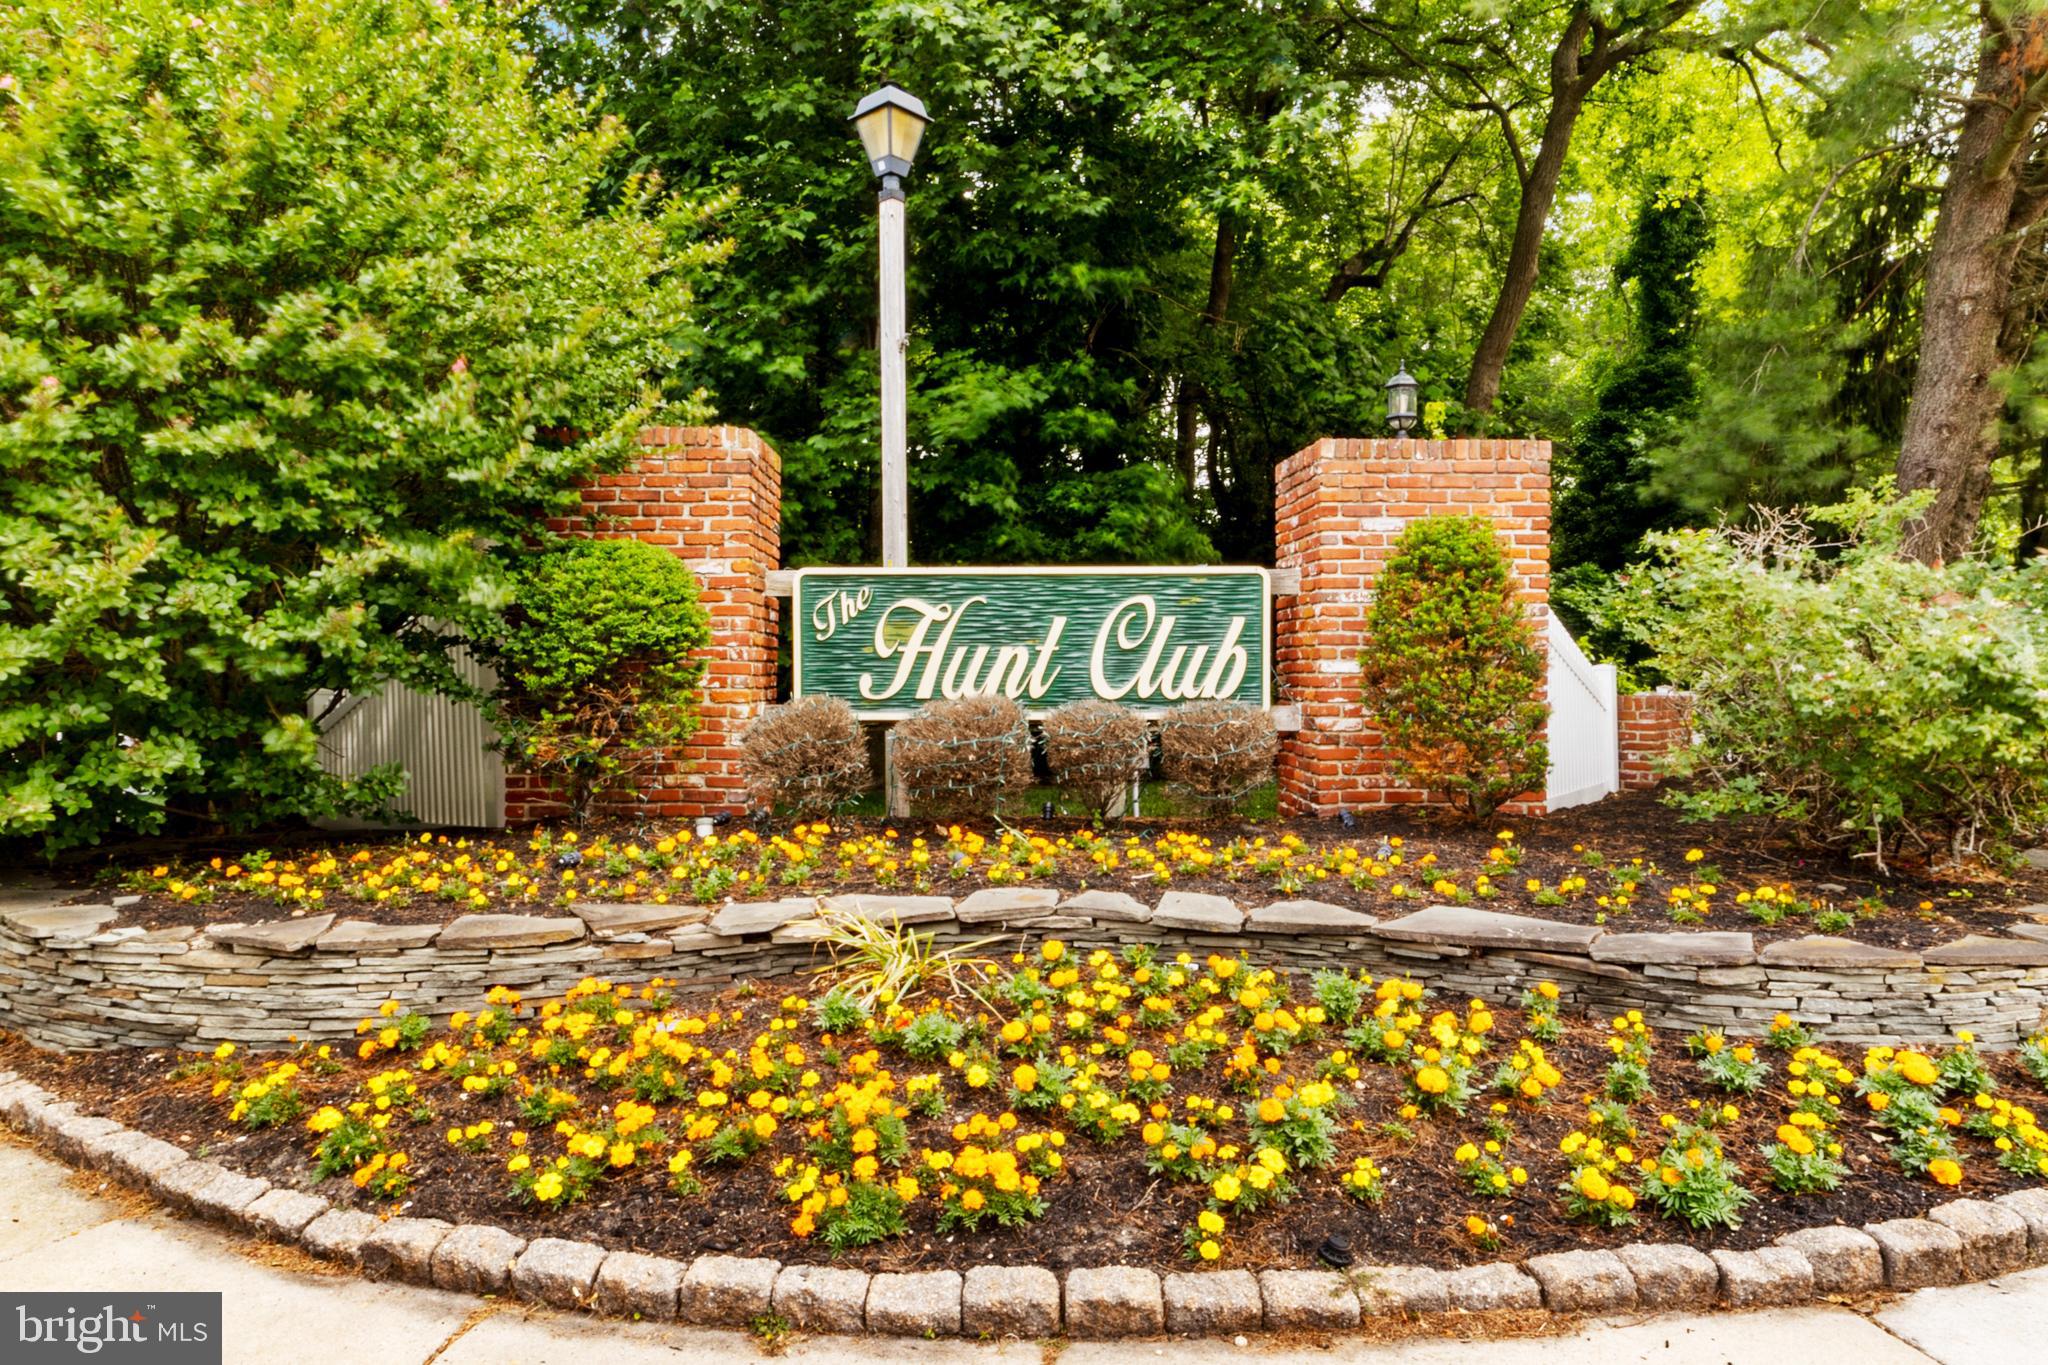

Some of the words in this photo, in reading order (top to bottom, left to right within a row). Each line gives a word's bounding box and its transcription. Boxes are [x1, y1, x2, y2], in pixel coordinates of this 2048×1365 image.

[812, 585, 875, 642] The
[858, 595, 1068, 700] Hunt
[1089, 594, 1248, 700] Club
